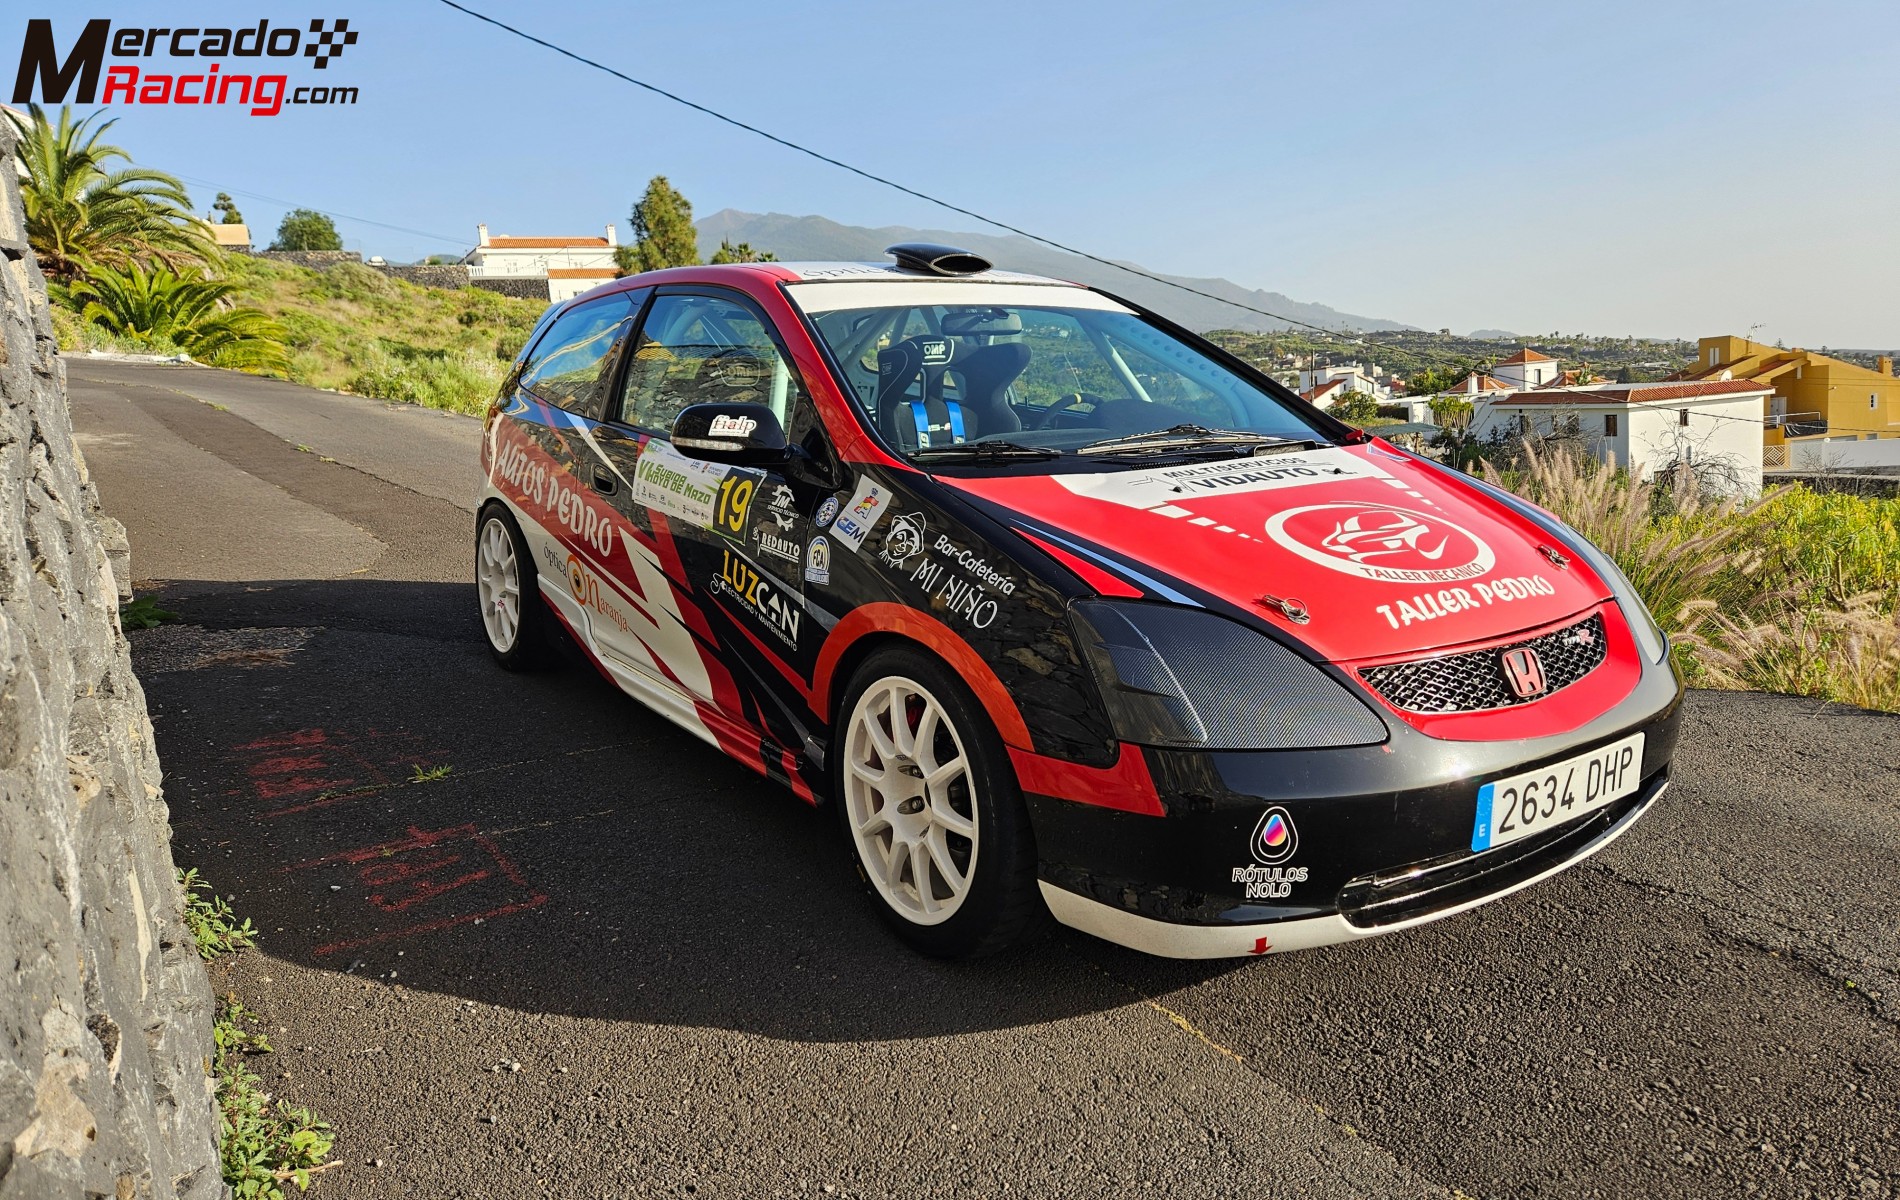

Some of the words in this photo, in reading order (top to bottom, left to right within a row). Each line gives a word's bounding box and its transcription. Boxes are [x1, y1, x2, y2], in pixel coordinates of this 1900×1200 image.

[923, 345, 946, 356] OMP
[1162, 457, 1307, 478] MULTISERVICIOS
[1190, 467, 1318, 489] VIDAUTO
[495, 439, 544, 505] AUTOS
[546, 476, 612, 557] PEDRO
[670, 480, 683, 495] DE
[718, 475, 753, 532] 19
[771, 494, 791, 509] JM
[761, 532, 800, 557] REDAUTO
[543, 541, 567, 578] óptica
[934, 535, 1016, 596] Bar-Cafetería
[1359, 567, 1426, 582] TALLER
[909, 557, 944, 593] MI
[935, 574, 998, 629] NIÑO
[1376, 588, 1481, 630] TALLER
[1472, 574, 1556, 606] PEDRO
[758, 612, 798, 652] MANTENIMIENTO
[1498, 767, 1575, 835] 2634
[1586, 745, 1634, 803] DHP
[1478, 823, 1486, 837] E
[1231, 863, 1309, 883] RÓTULOS
[1245, 882, 1292, 899] NOLO
